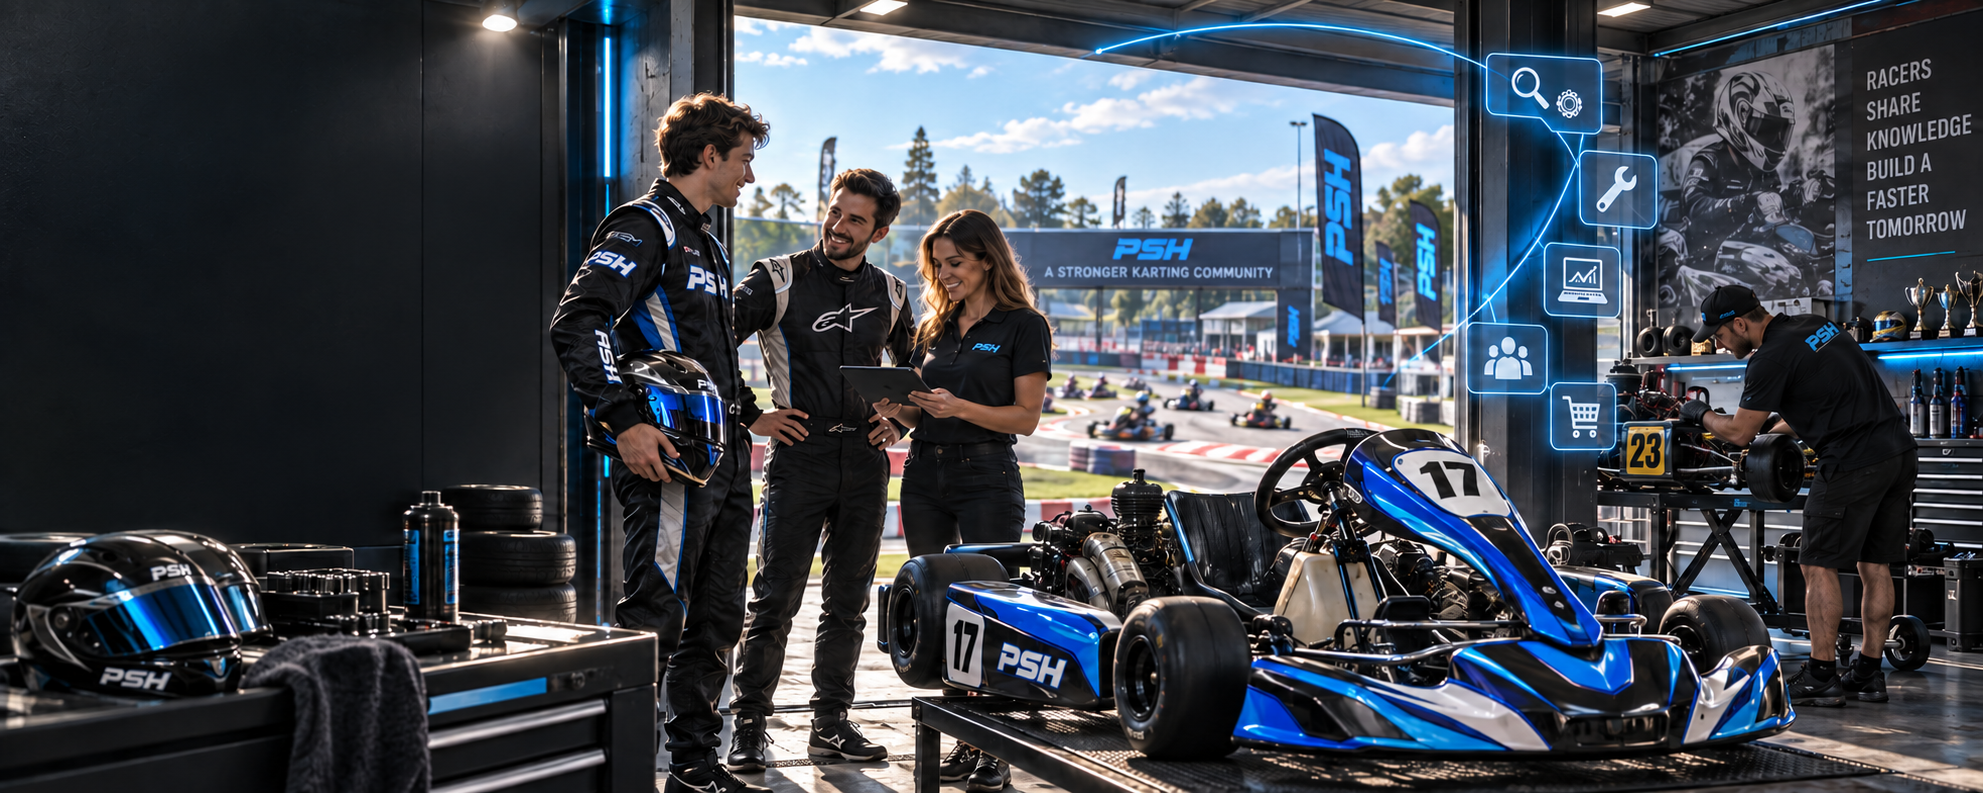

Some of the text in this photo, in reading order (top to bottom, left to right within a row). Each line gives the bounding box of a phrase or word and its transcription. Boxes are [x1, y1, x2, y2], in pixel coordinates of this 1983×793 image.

[1867, 58, 1932, 91] RACERS
[1866, 92, 1921, 121] SHARE
[1867, 114, 1972, 151] KNOWLEDGE
[1867, 152, 1932, 181] BUILD A
[1324, 148, 1353, 266] PSH
[1867, 183, 1929, 211] FASTER
[1866, 209, 1967, 240] TOMORROW
[586, 250, 638, 279] PSH
[1112, 238, 1194, 261] PSH
[1416, 223, 1437, 301] PSH
[686, 265, 728, 300] PSH
[1044, 266, 1274, 279] A STRONGER KARTING COMMUNITY
[971, 342, 1001, 354] PSH
[1804, 321, 1841, 352] PSH
[1629, 433, 1662, 469] 23
[1419, 461, 1480, 500] 17
[150, 563, 192, 581] PSH
[953, 619, 979, 674] 17
[99, 666, 172, 691] PSH
[996, 641, 1068, 690] PSH
